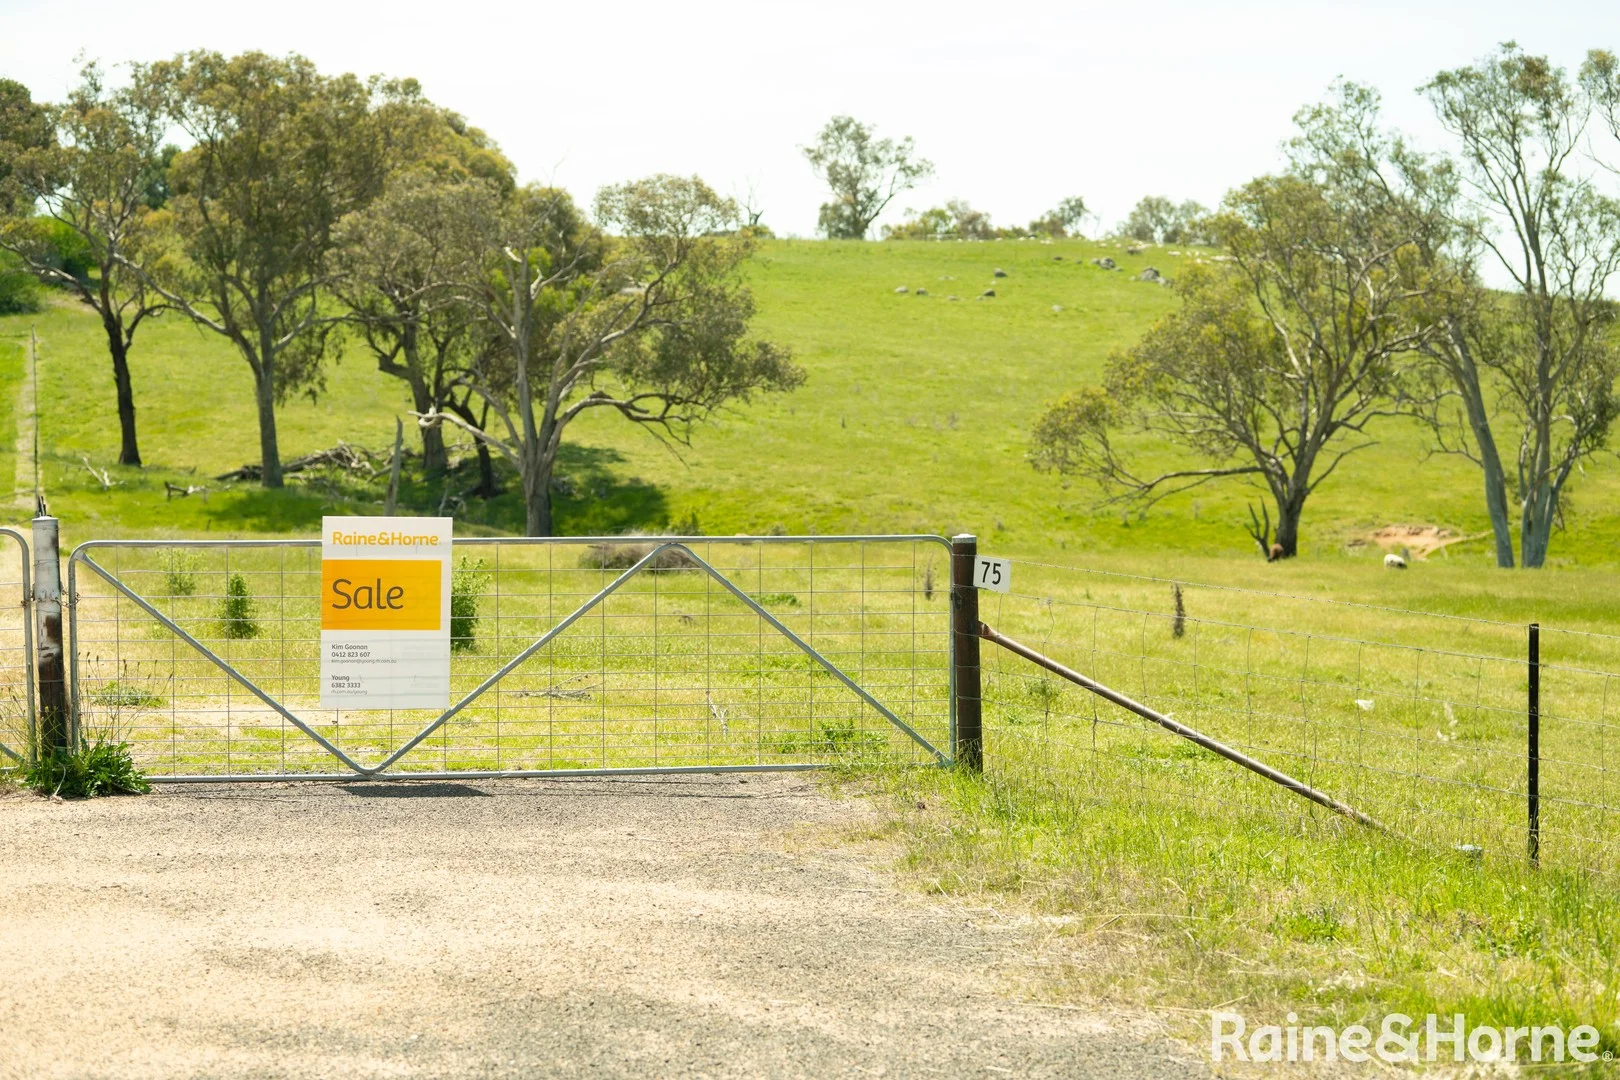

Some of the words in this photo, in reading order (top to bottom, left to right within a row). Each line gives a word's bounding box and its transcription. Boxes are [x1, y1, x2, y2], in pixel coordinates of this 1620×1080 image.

[332, 531, 439, 547] Raine&Horne
[981, 561, 1002, 585] 75
[331, 578, 404, 610] Sale
[331, 674, 350, 682] Young
